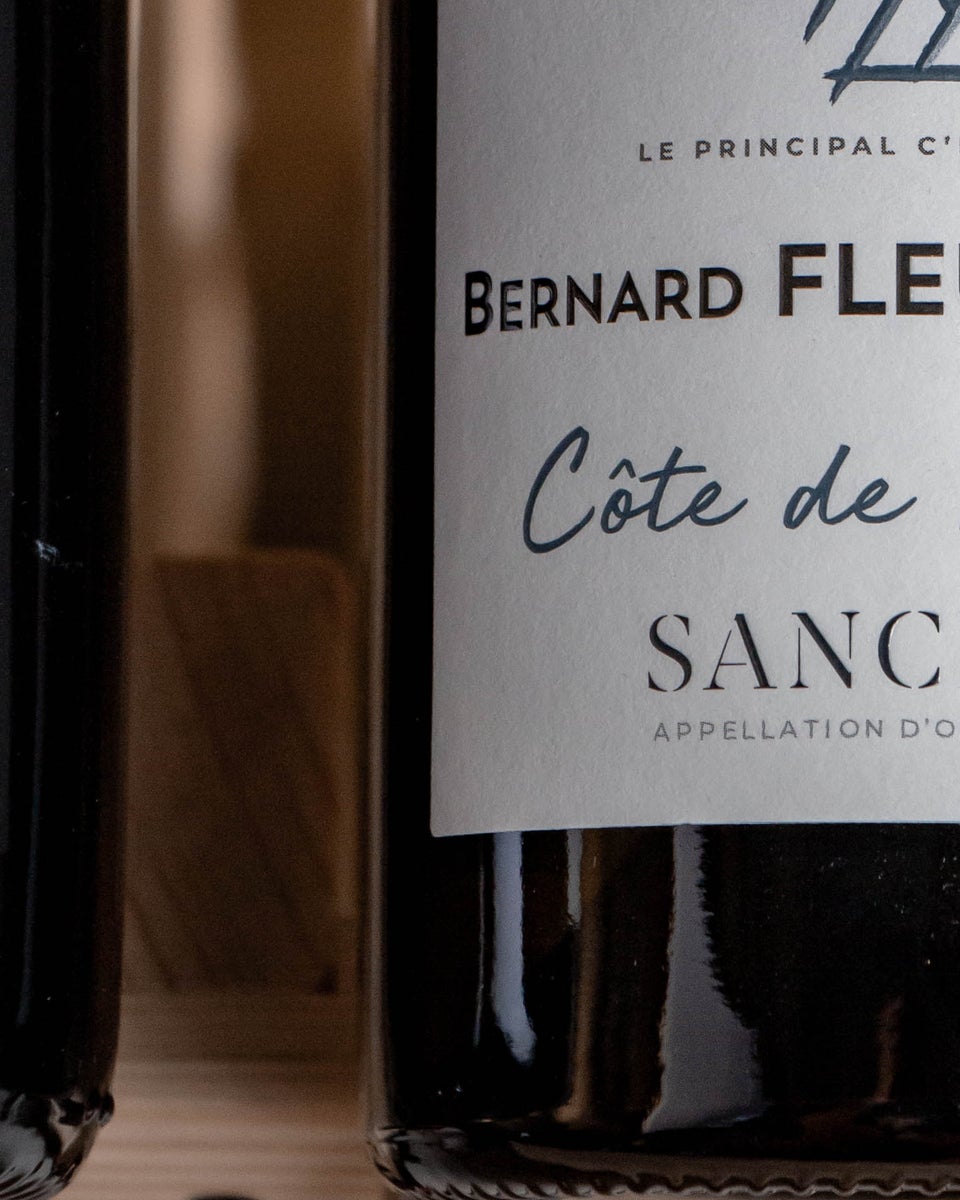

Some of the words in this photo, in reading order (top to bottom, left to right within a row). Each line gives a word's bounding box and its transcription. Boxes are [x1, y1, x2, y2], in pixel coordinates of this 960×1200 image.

[640, 142, 674, 163] LE
[694, 137, 895, 160] PRINCIPAL
[522, 425, 749, 555] Côte
[782, 443, 918, 530] de
[654, 719, 883, 742] APPELLATION
